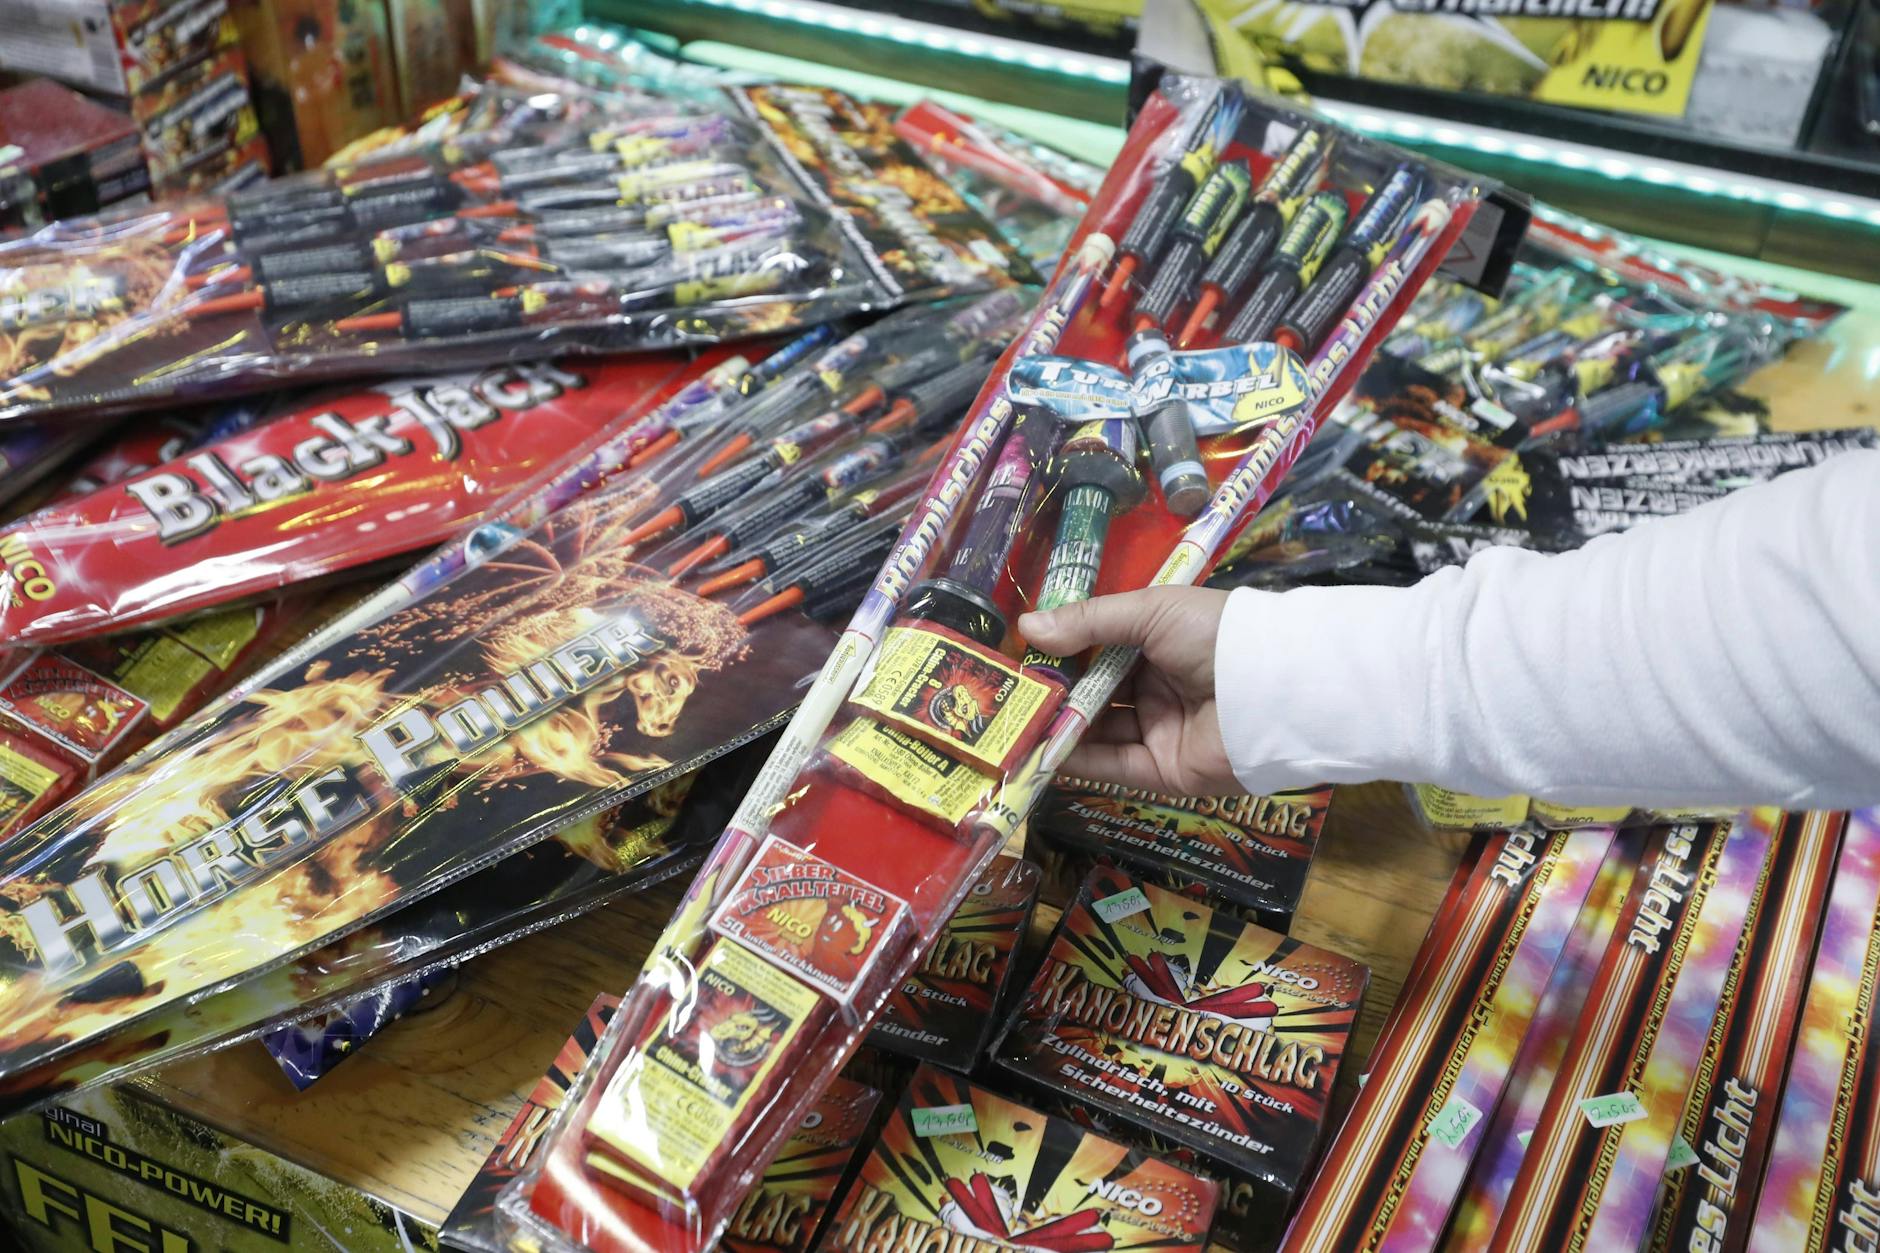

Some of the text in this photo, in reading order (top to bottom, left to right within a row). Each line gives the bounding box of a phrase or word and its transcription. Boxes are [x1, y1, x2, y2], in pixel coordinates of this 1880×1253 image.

[1582, 65, 1670, 95] NICO
[1255, 396, 1286, 411] NICO
[126, 359, 590, 547] Black Jack
[875, 397, 1013, 603] Römisches
[1019, 301, 1071, 364] cht
[1063, 489, 1108, 515] FONT
[0, 534, 57, 603] NICO
[1042, 565, 1094, 595] GRE
[898, 648, 947, 709] China-Cracker
[927, 678, 943, 690] 8
[994, 677, 1016, 704] NICO
[938, 760, 950, 772] A
[14, 760, 376, 975] HORSE
[352, 606, 670, 790] POWER
[1067, 800, 1182, 845] Zylindrisch,
[1187, 837, 1225, 859] mit
[1244, 838, 1289, 860] Stück
[751, 863, 836, 888] SILBER
[1085, 823, 1275, 892] Sicherheitszünder
[1527, 830, 1569, 908] euchtkugeln
[735, 880, 887, 916] KNALLTEUFEL
[1628, 860, 1690, 955] Licht
[766, 908, 814, 940] NICO
[1669, 887, 1710, 974] Leuchtkugeln
[703, 972, 736, 997] NICO
[779, 948, 848, 994] Trickknaller
[1251, 959, 1320, 990] NICO
[919, 988, 968, 1008] Stück
[1472, 999, 1496, 1027] 15
[1654, 984, 1672, 1019] Inhalt
[1041, 960, 1325, 1090] KANONENSCHLAG
[655, 1044, 734, 1100] China-Crker
[1040, 1033, 1218, 1115] Zylindrisch, mit
[1423, 1023, 1479, 1128] Leuchtkugeln
[1831, 1105, 1848, 1143] Inhalt
[1846, 1016, 1865, 1046] 15
[1059, 1063, 1275, 1156] Sicherheitszünder
[1218, 1080, 1294, 1115] 10 Stück
[1683, 1056, 1716, 1145] uchtkugeln
[45, 1105, 101, 1138] ginal
[1698, 1077, 1759, 1199] Licht
[49, 1121, 282, 1236] NICO-POWER!
[1399, 1138, 1425, 1181] Inhalt
[1580, 1121, 1625, 1218] uchtkugeln
[1086, 1178, 1164, 1216] NICO
